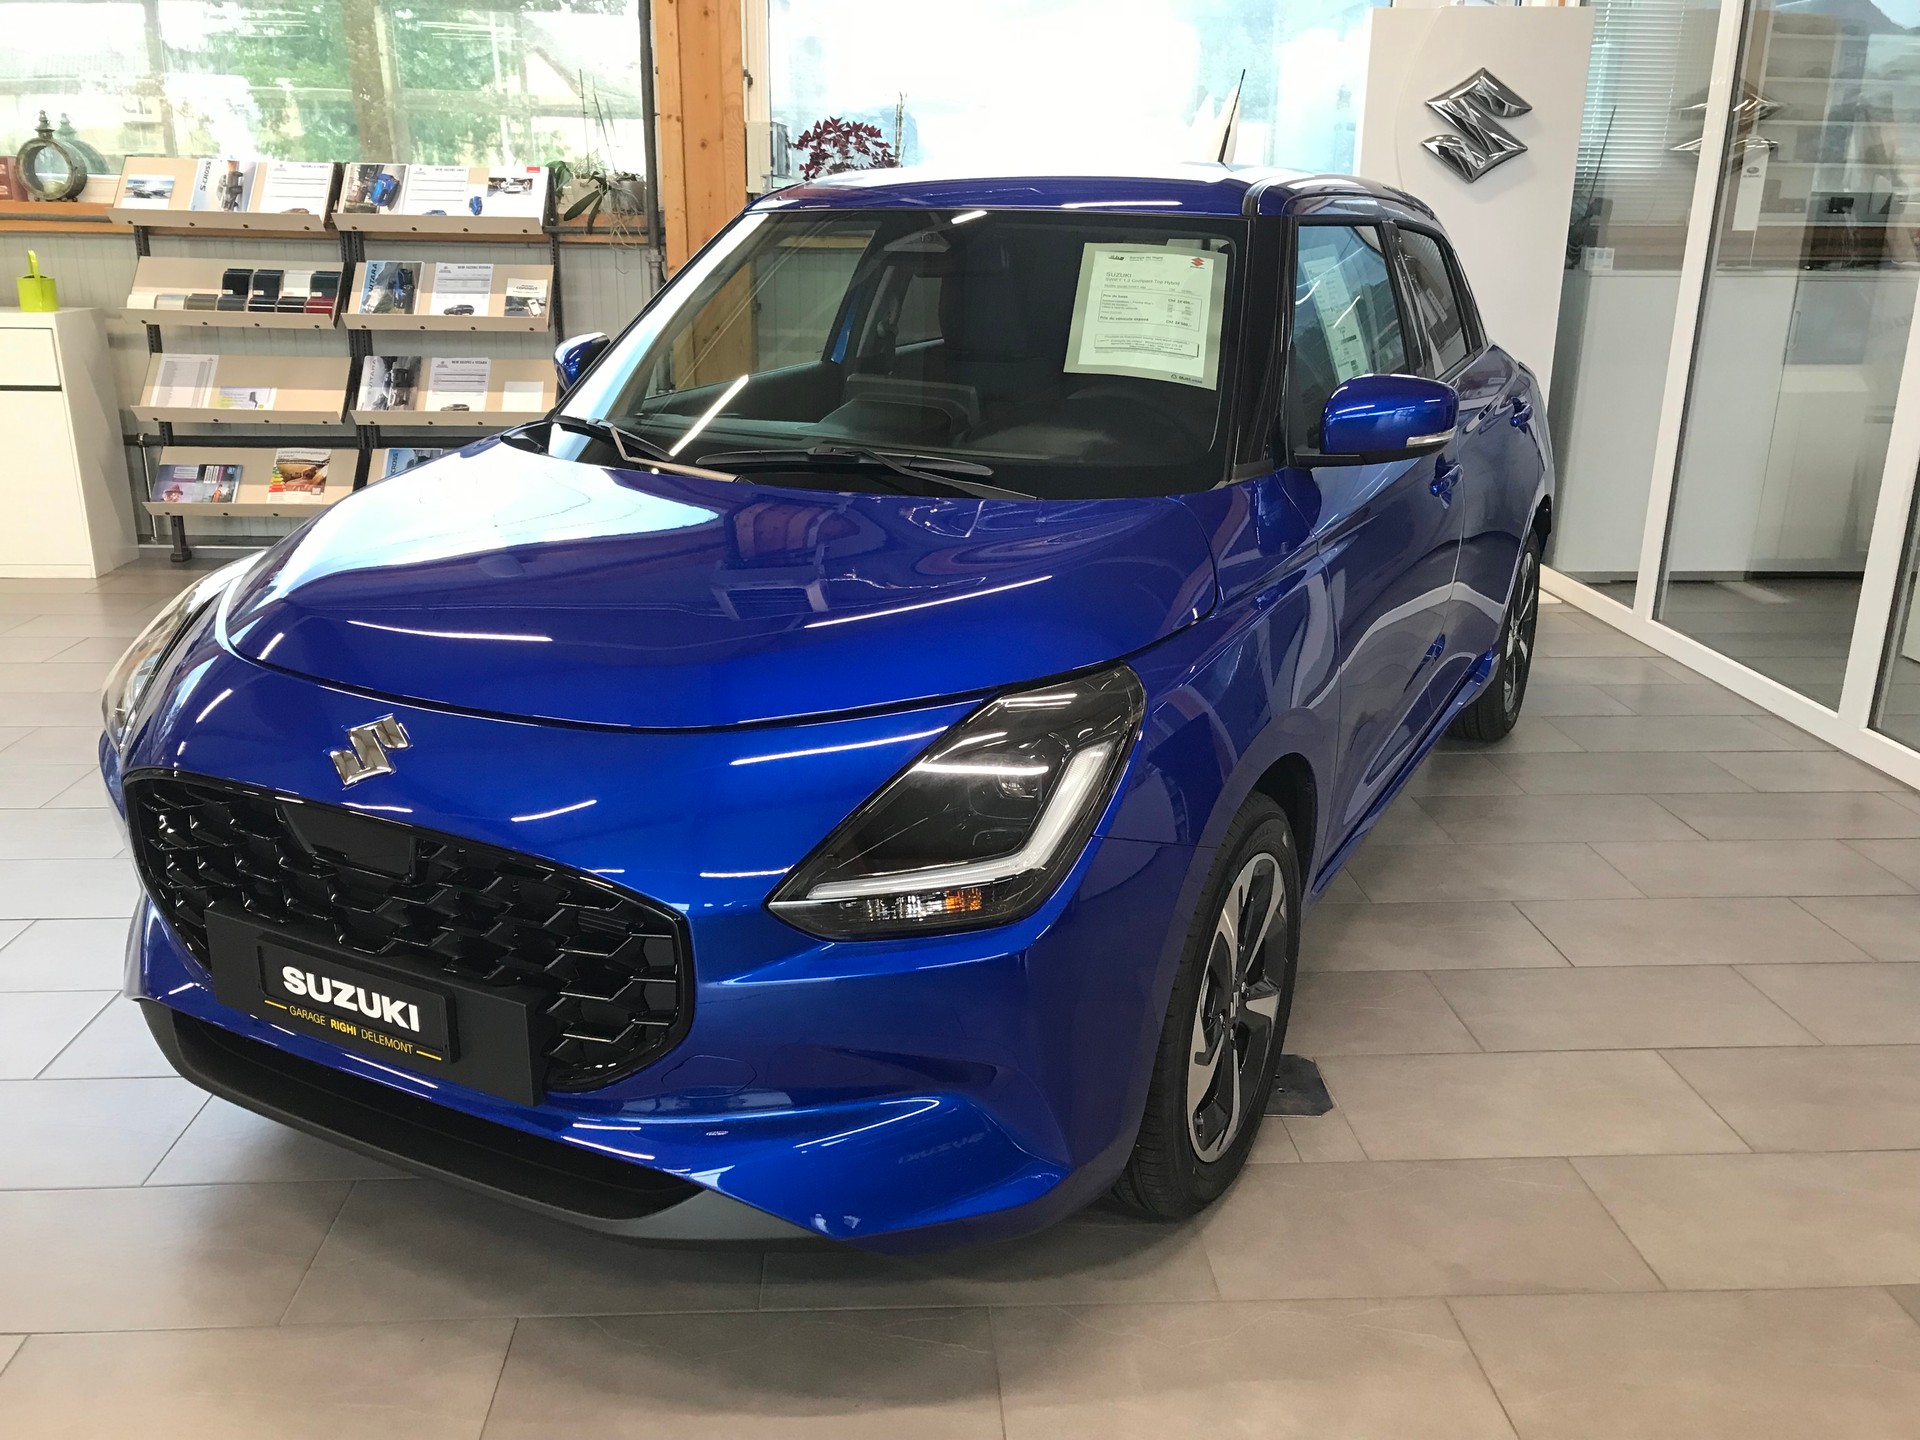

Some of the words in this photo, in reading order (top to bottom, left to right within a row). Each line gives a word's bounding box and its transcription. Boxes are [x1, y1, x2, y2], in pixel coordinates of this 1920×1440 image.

[368, 263, 378, 293] VITARA
[368, 358, 378, 390] VITARA
[282, 966, 420, 1033] SUZUKI
[289, 1005, 326, 1026] GARAGE
[330, 1018, 357, 1036] RIGHI
[361, 1029, 414, 1055] DELEMONT
